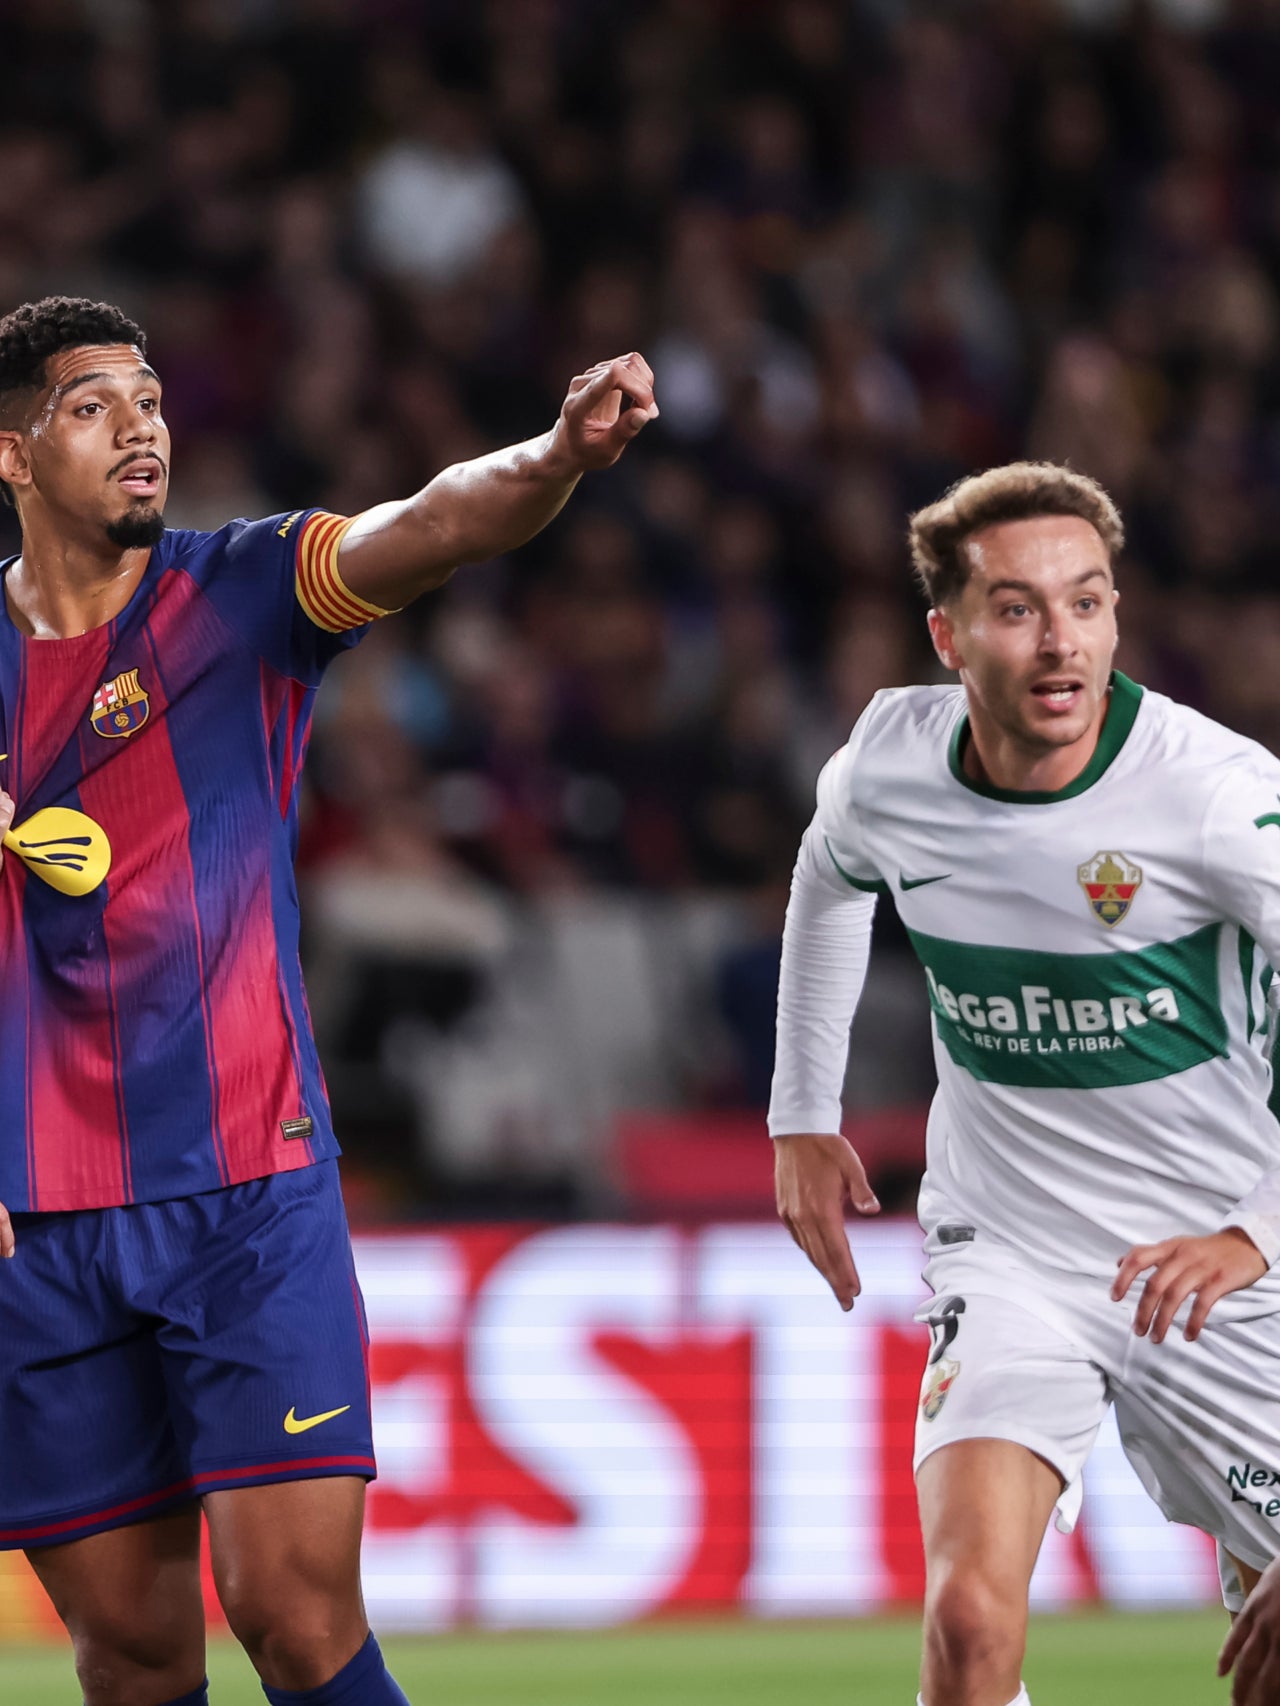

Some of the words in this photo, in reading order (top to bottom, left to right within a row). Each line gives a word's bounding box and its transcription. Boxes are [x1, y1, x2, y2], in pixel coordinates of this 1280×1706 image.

[973, 1032, 1001, 1051] REY
[1008, 1037, 1031, 1053] DE
[1037, 1037, 1062, 1053] LA
[1067, 1034, 1125, 1053] FIBRA
